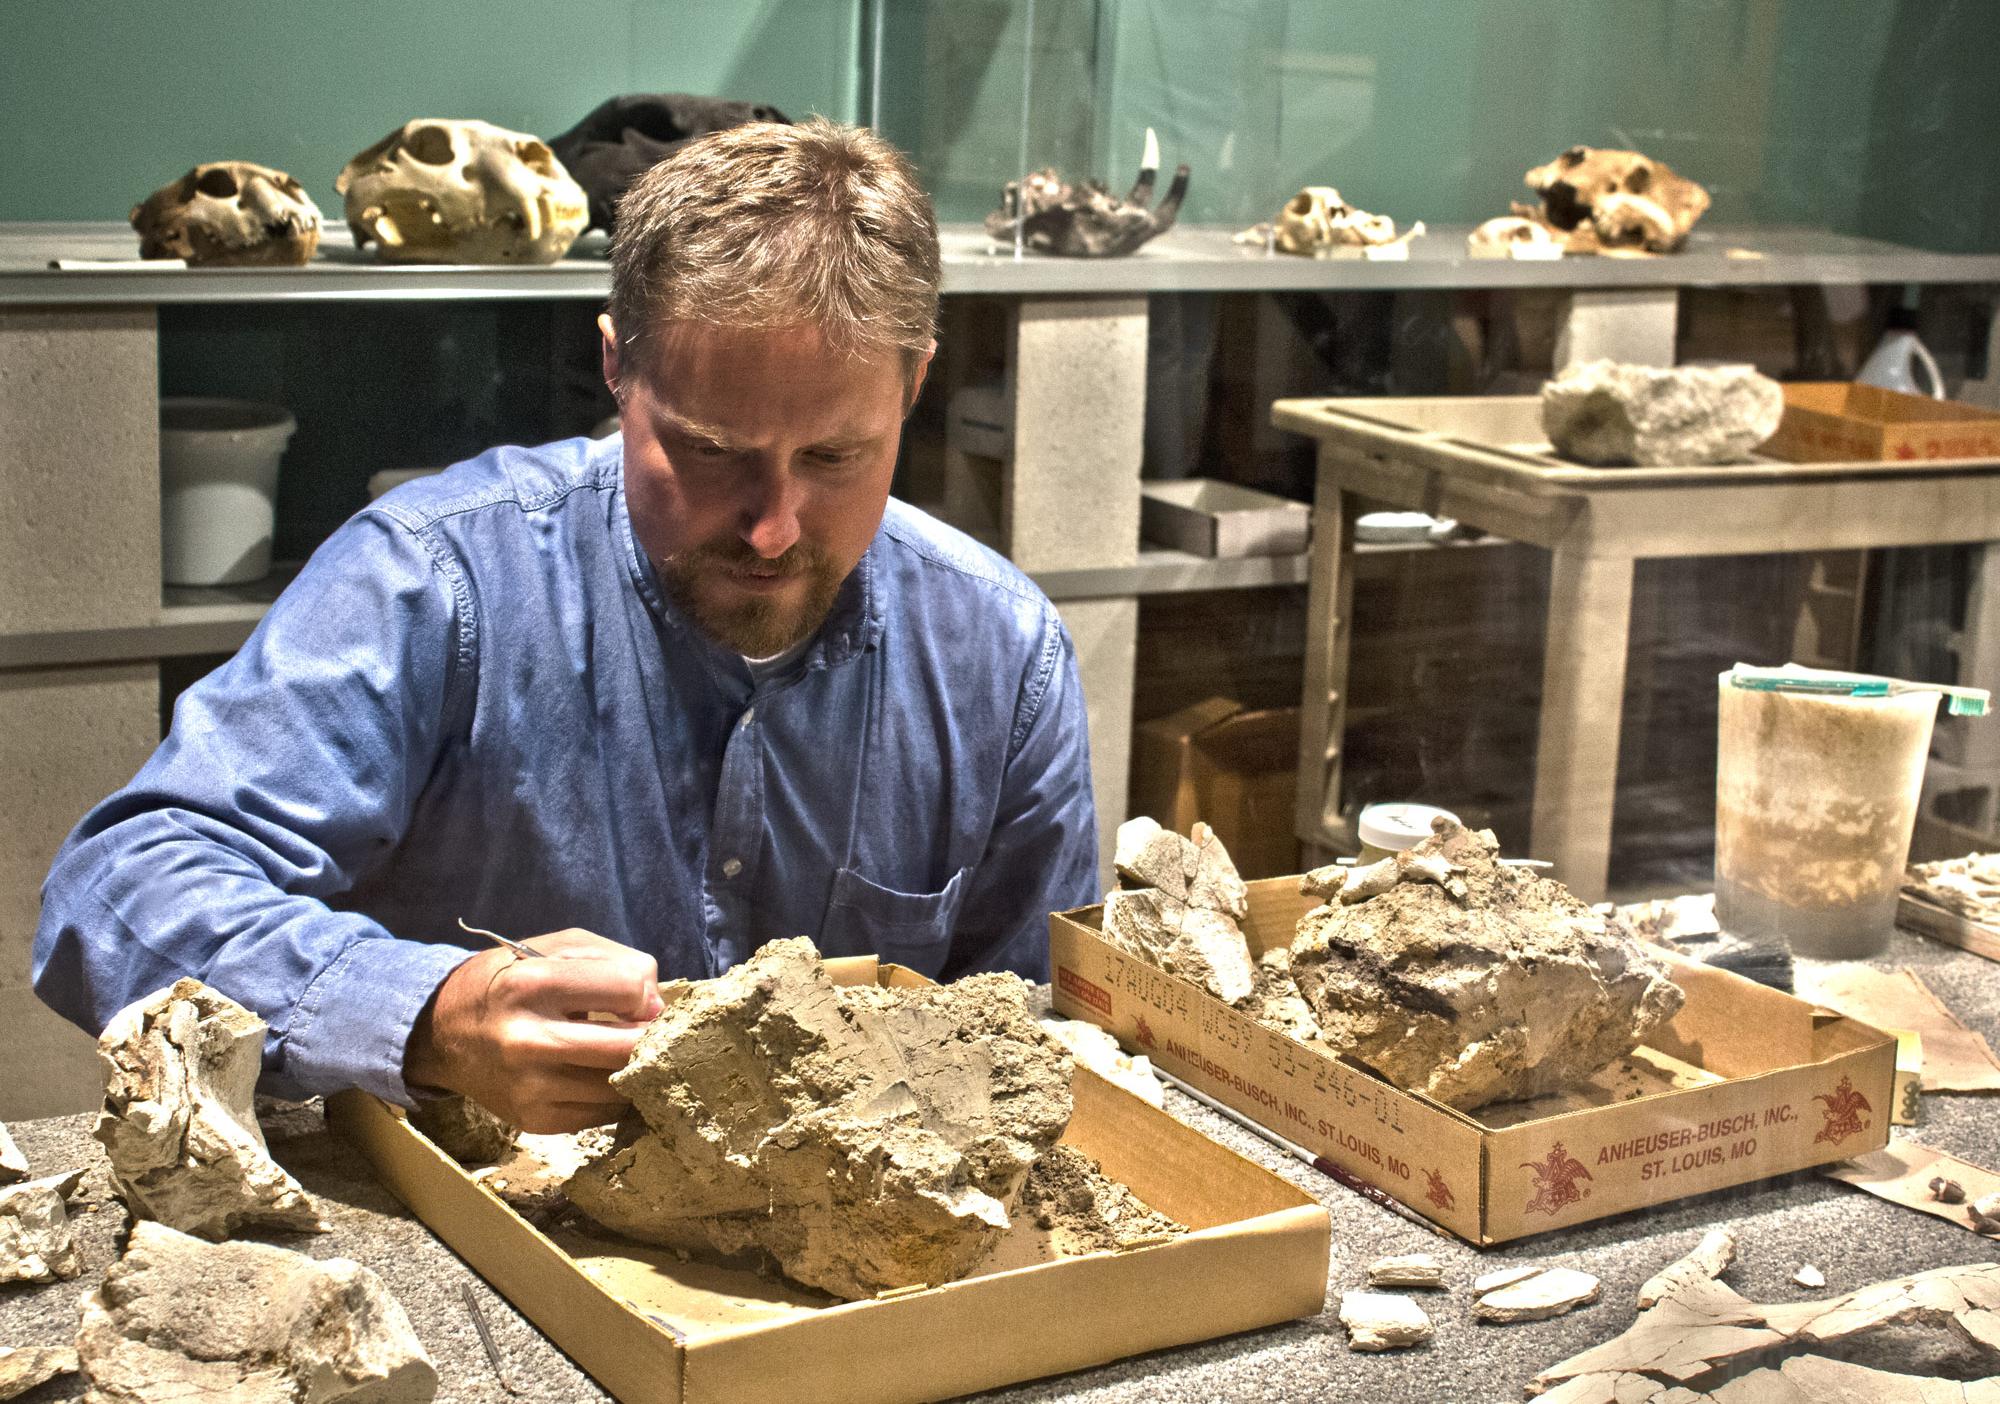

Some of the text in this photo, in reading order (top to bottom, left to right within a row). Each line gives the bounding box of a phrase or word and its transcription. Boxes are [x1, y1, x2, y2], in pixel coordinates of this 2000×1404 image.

[1105, 953, 1187, 1021] 17AUG04
[1268, 1035, 1404, 1134] 53-246-01
[1166, 1039, 1282, 1116] ANHEUSER-BUSCH,
[1285, 1101, 1315, 1133] INC.,
[1388, 1155, 1410, 1180] MO
[1597, 1104, 1798, 1166] ANHEUSER-BUSCH, INC.,
[1641, 1138, 1757, 1181] ST. LOUIS, MO
